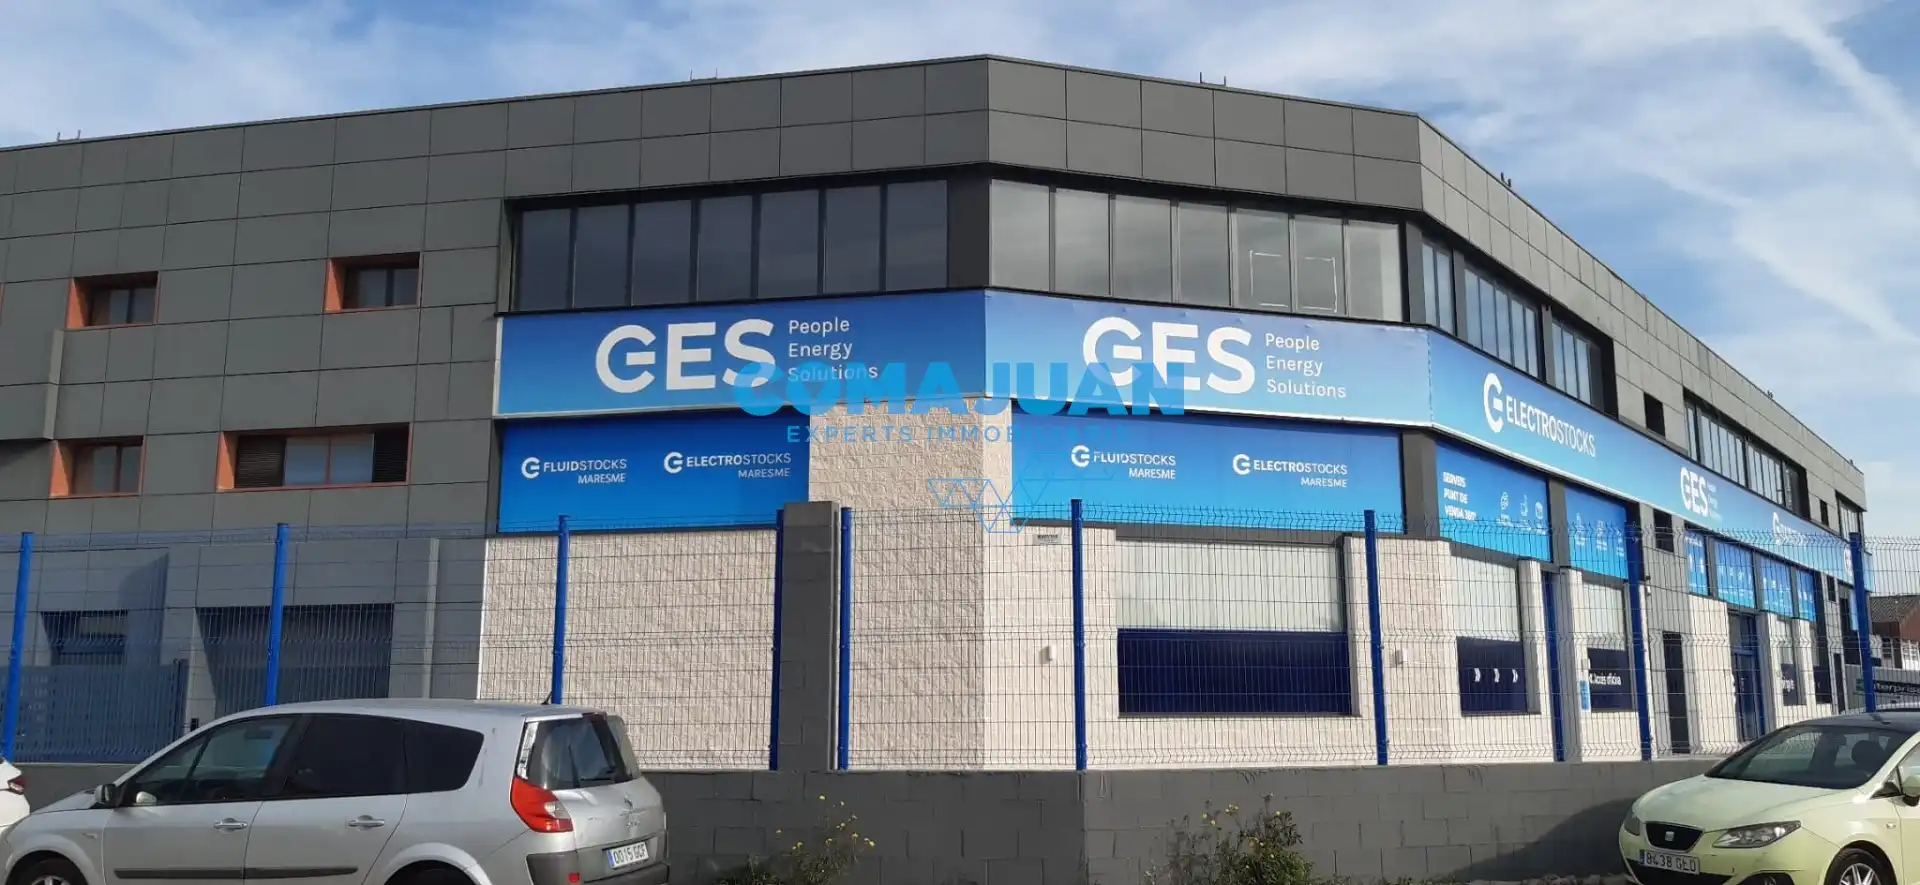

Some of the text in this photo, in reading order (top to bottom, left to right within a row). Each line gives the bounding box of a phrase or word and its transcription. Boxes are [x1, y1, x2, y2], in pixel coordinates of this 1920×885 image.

[788, 316, 850, 338] People
[788, 341, 853, 360] Energy
[1265, 332, 1320, 353] People
[595, 318, 775, 394] GES
[1082, 316, 1256, 394] GES
[788, 363, 878, 382] Solutions
[1265, 355, 1323, 377] Energy
[1266, 377, 1346, 399] Solutions
[1506, 394, 1597, 458] ELECTROSTOCKS
[543, 458, 627, 472] FLUIDSTOCKS
[686, 452, 791, 468] ELECTROSTOCKS
[1093, 452, 1176, 466] FLUIDSTOCKS
[1253, 459, 1347, 476] ELECTROSTOCKS
[577, 472, 626, 484] MARESME
[738, 467, 790, 478] MARESME
[1128, 467, 1176, 480] MARESME
[1300, 475, 1347, 488] MARESME
[1680, 466, 1709, 517] GES
